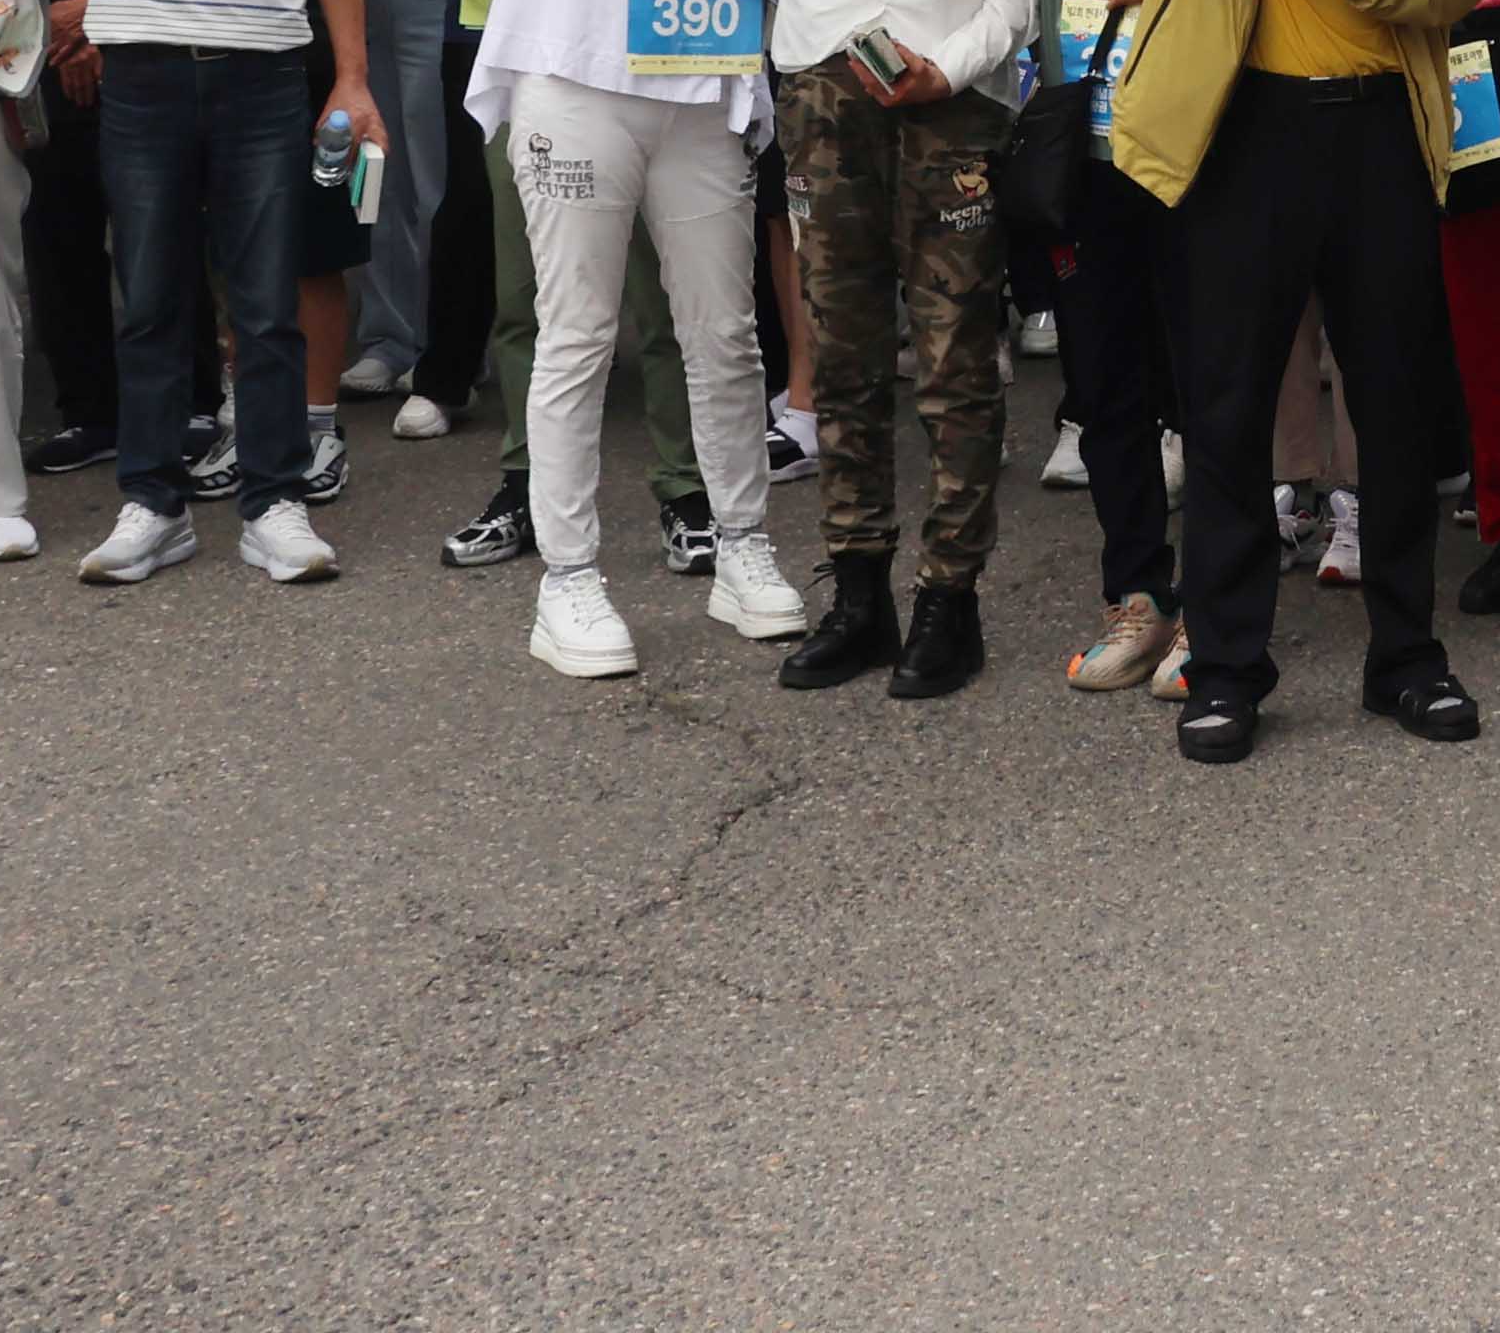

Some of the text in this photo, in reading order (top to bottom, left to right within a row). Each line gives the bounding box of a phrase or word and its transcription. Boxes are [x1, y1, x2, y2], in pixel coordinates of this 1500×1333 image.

[551, 159, 594, 171] WOKE
[554, 171, 594, 183] THIS
[536, 182, 596, 199] CUTE!
[940, 204, 982, 222] Keep
